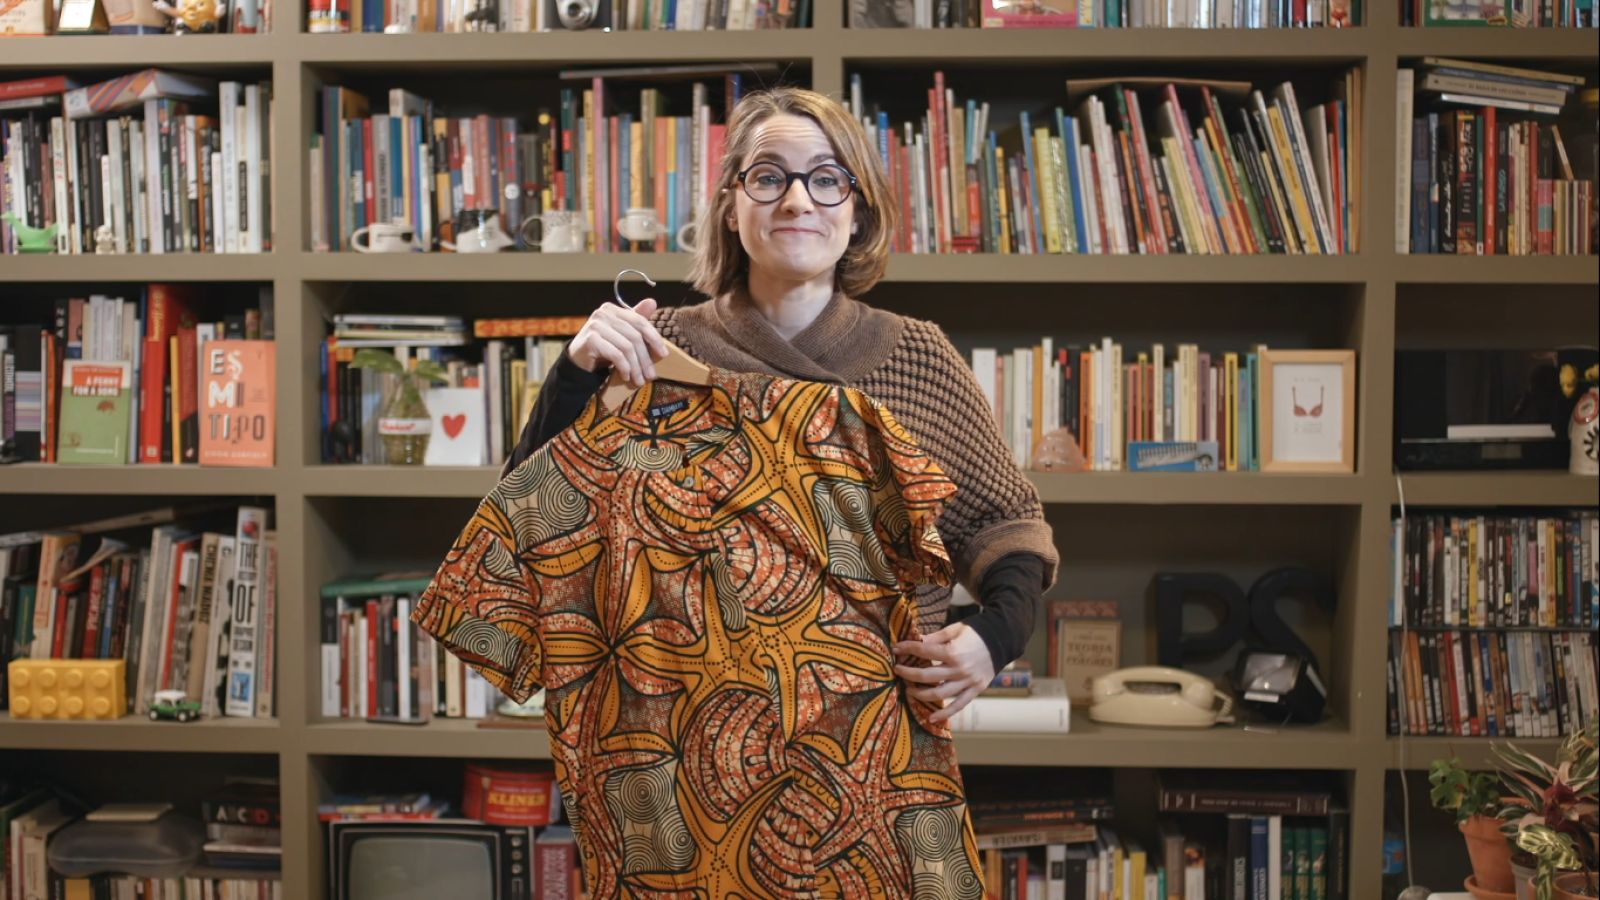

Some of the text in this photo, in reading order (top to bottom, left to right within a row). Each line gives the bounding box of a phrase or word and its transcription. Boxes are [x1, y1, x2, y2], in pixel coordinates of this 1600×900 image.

[210, 349, 243, 380] ES
[208, 380, 245, 408] MI
[208, 413, 265, 445] TIPO
[239, 542, 259, 568] THE
[235, 584, 255, 624] OF
